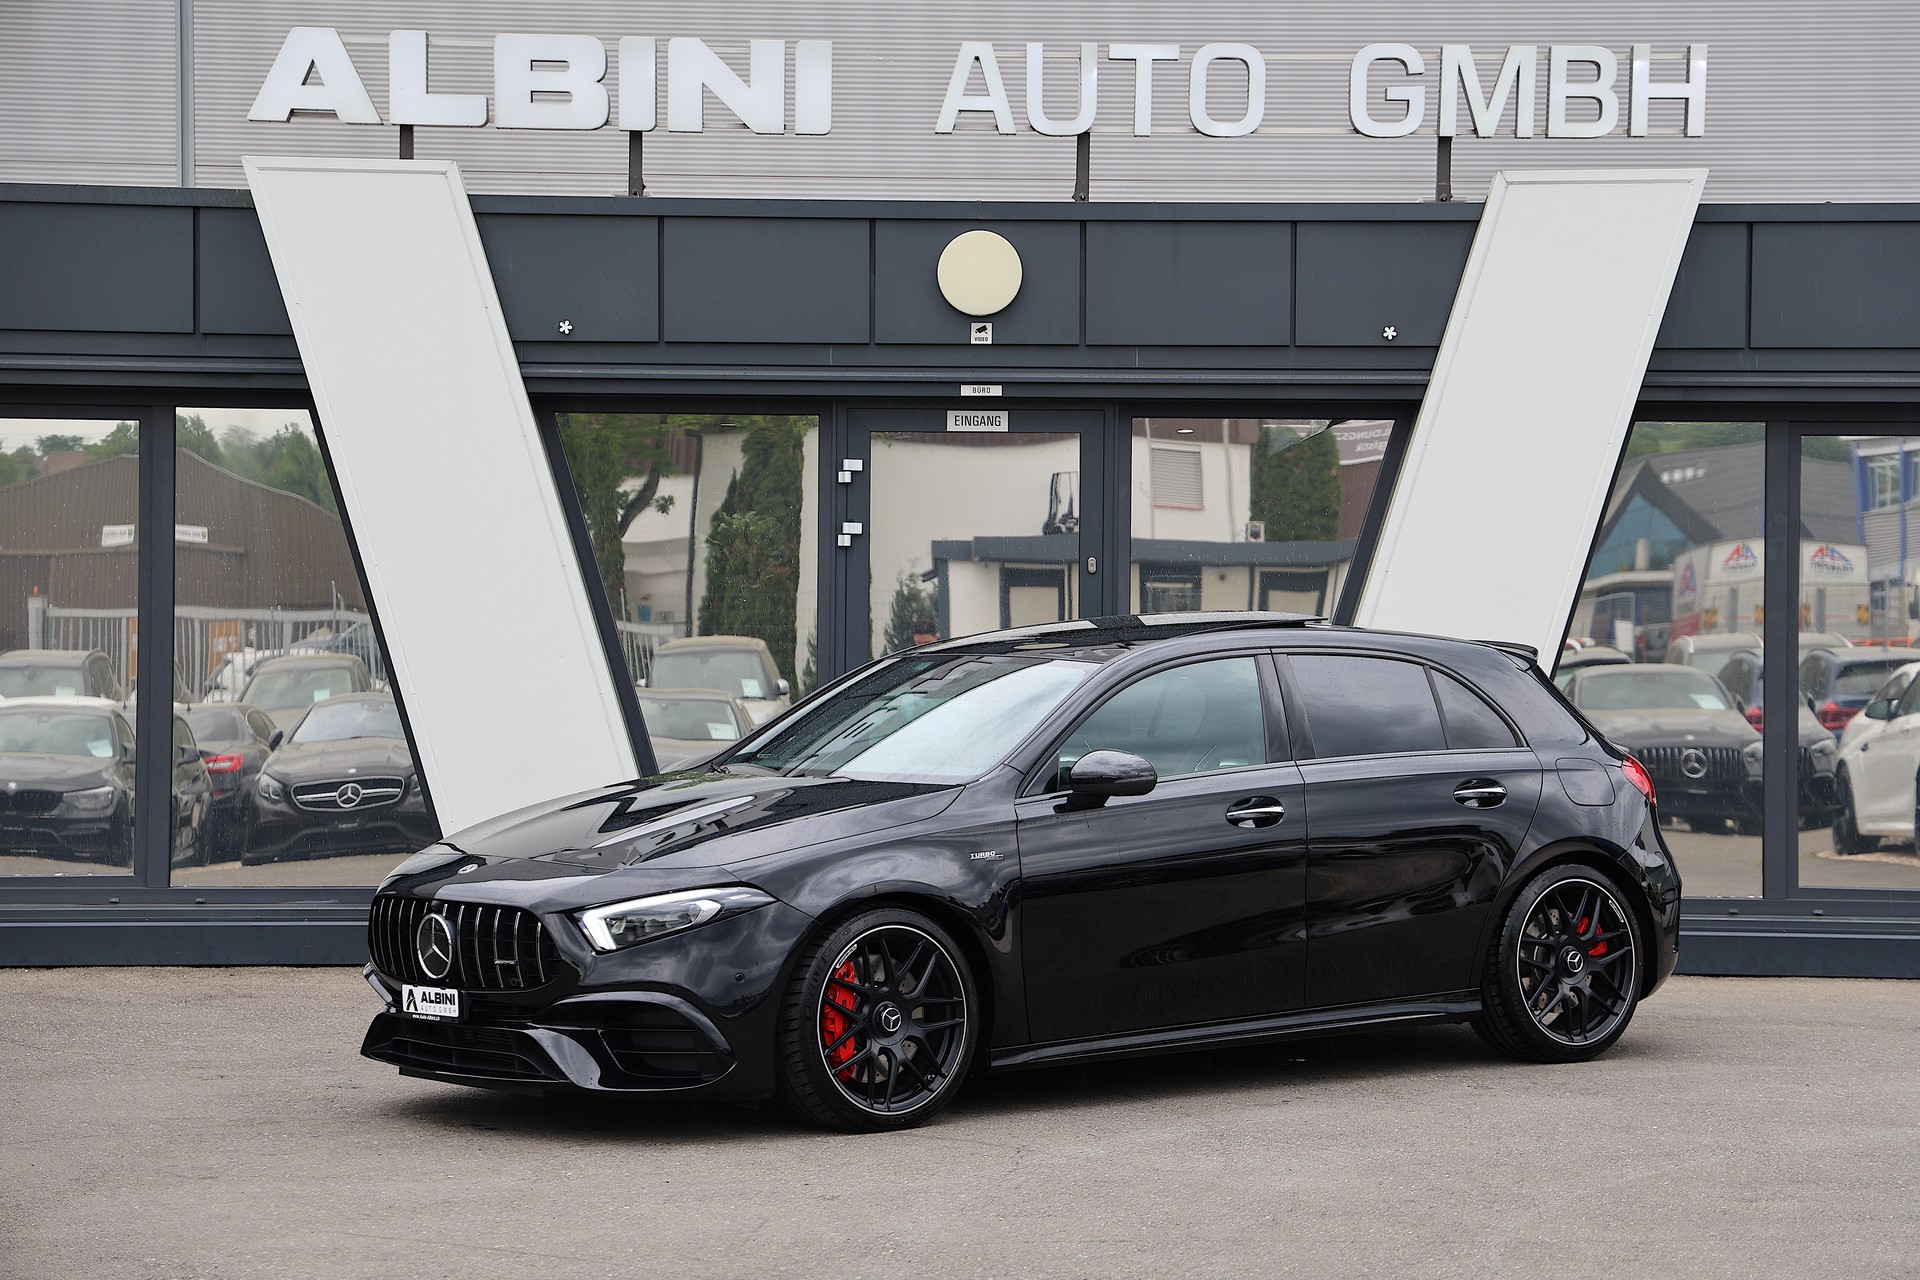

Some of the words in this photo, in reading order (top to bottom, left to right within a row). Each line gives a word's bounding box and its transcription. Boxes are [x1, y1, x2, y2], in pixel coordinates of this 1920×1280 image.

[247, 26, 833, 136] ALBINI
[935, 41, 1266, 138] AUTO
[1349, 42, 1708, 139] GMBH
[972, 385, 991, 394] BÜRO
[954, 415, 1002, 427] EINGANG
[421, 991, 455, 1005] ALBINI
